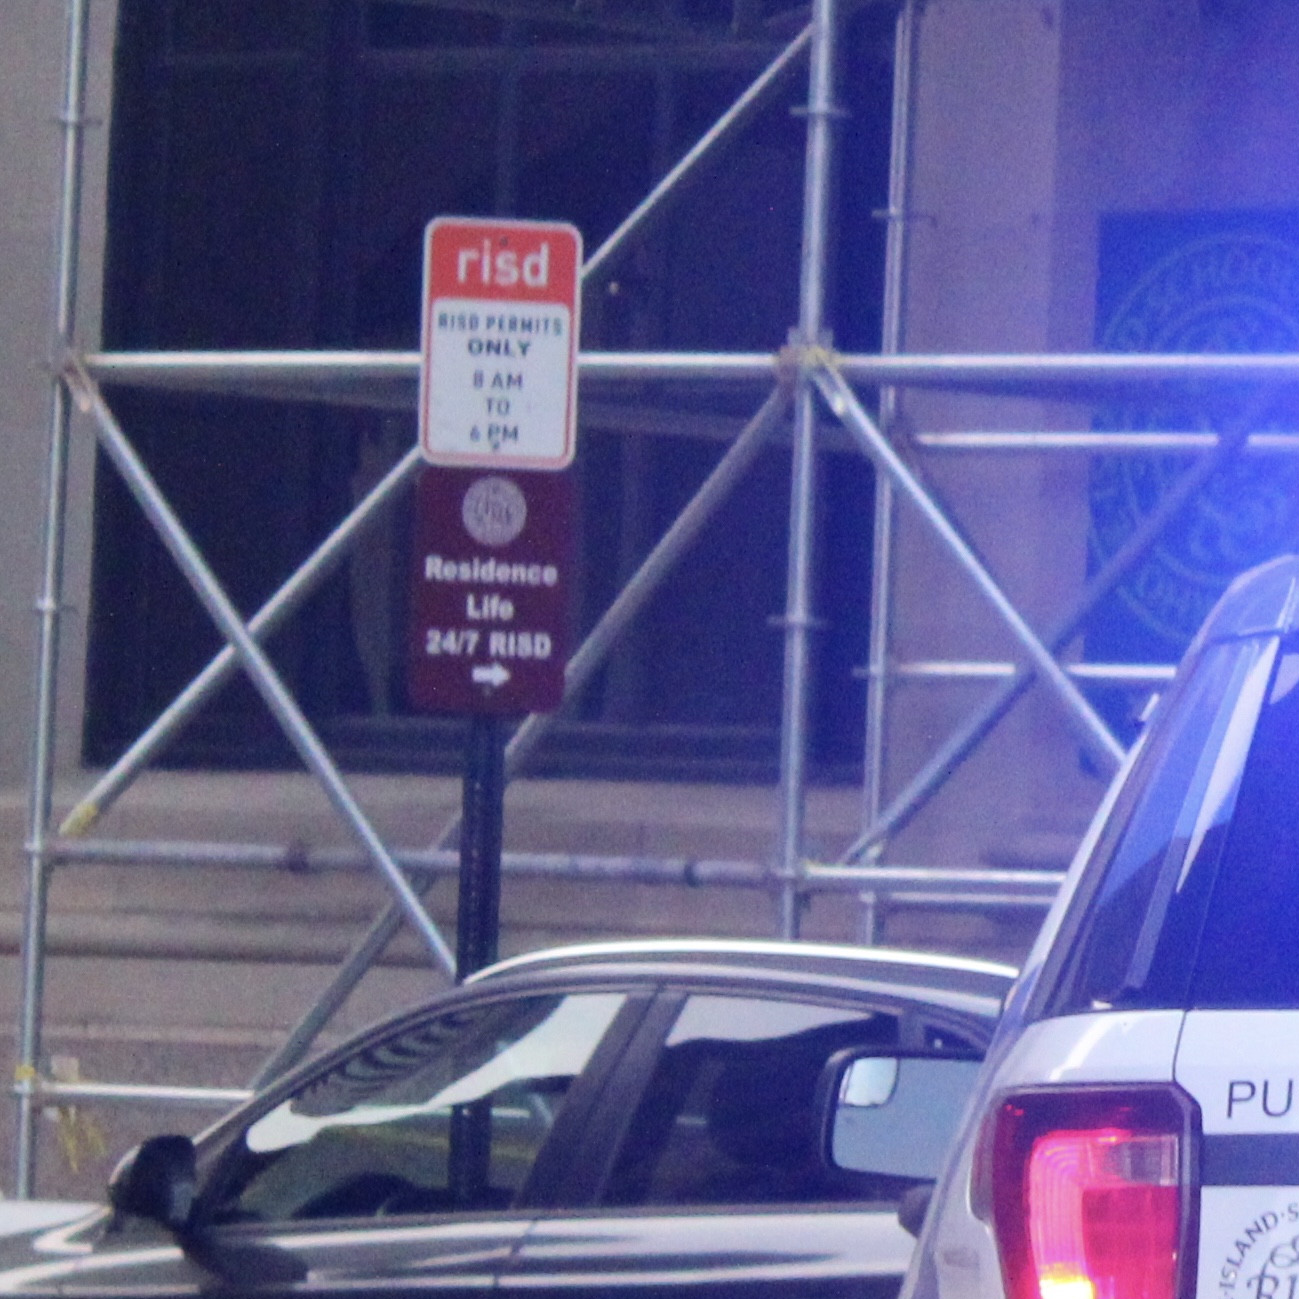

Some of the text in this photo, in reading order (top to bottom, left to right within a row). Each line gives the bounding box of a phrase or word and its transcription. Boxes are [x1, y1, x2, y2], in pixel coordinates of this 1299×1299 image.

[457, 239, 550, 288] risd
[438, 312, 562, 336] RISD PERMITS
[467, 339, 531, 357] ONLY
[491, 371, 523, 389] AM
[487, 397, 510, 416] TO
[487, 423, 518, 442] PM
[425, 554, 558, 588] Residence
[466, 593, 515, 621] Life
[426, 629, 552, 659] 24/7 RISD
